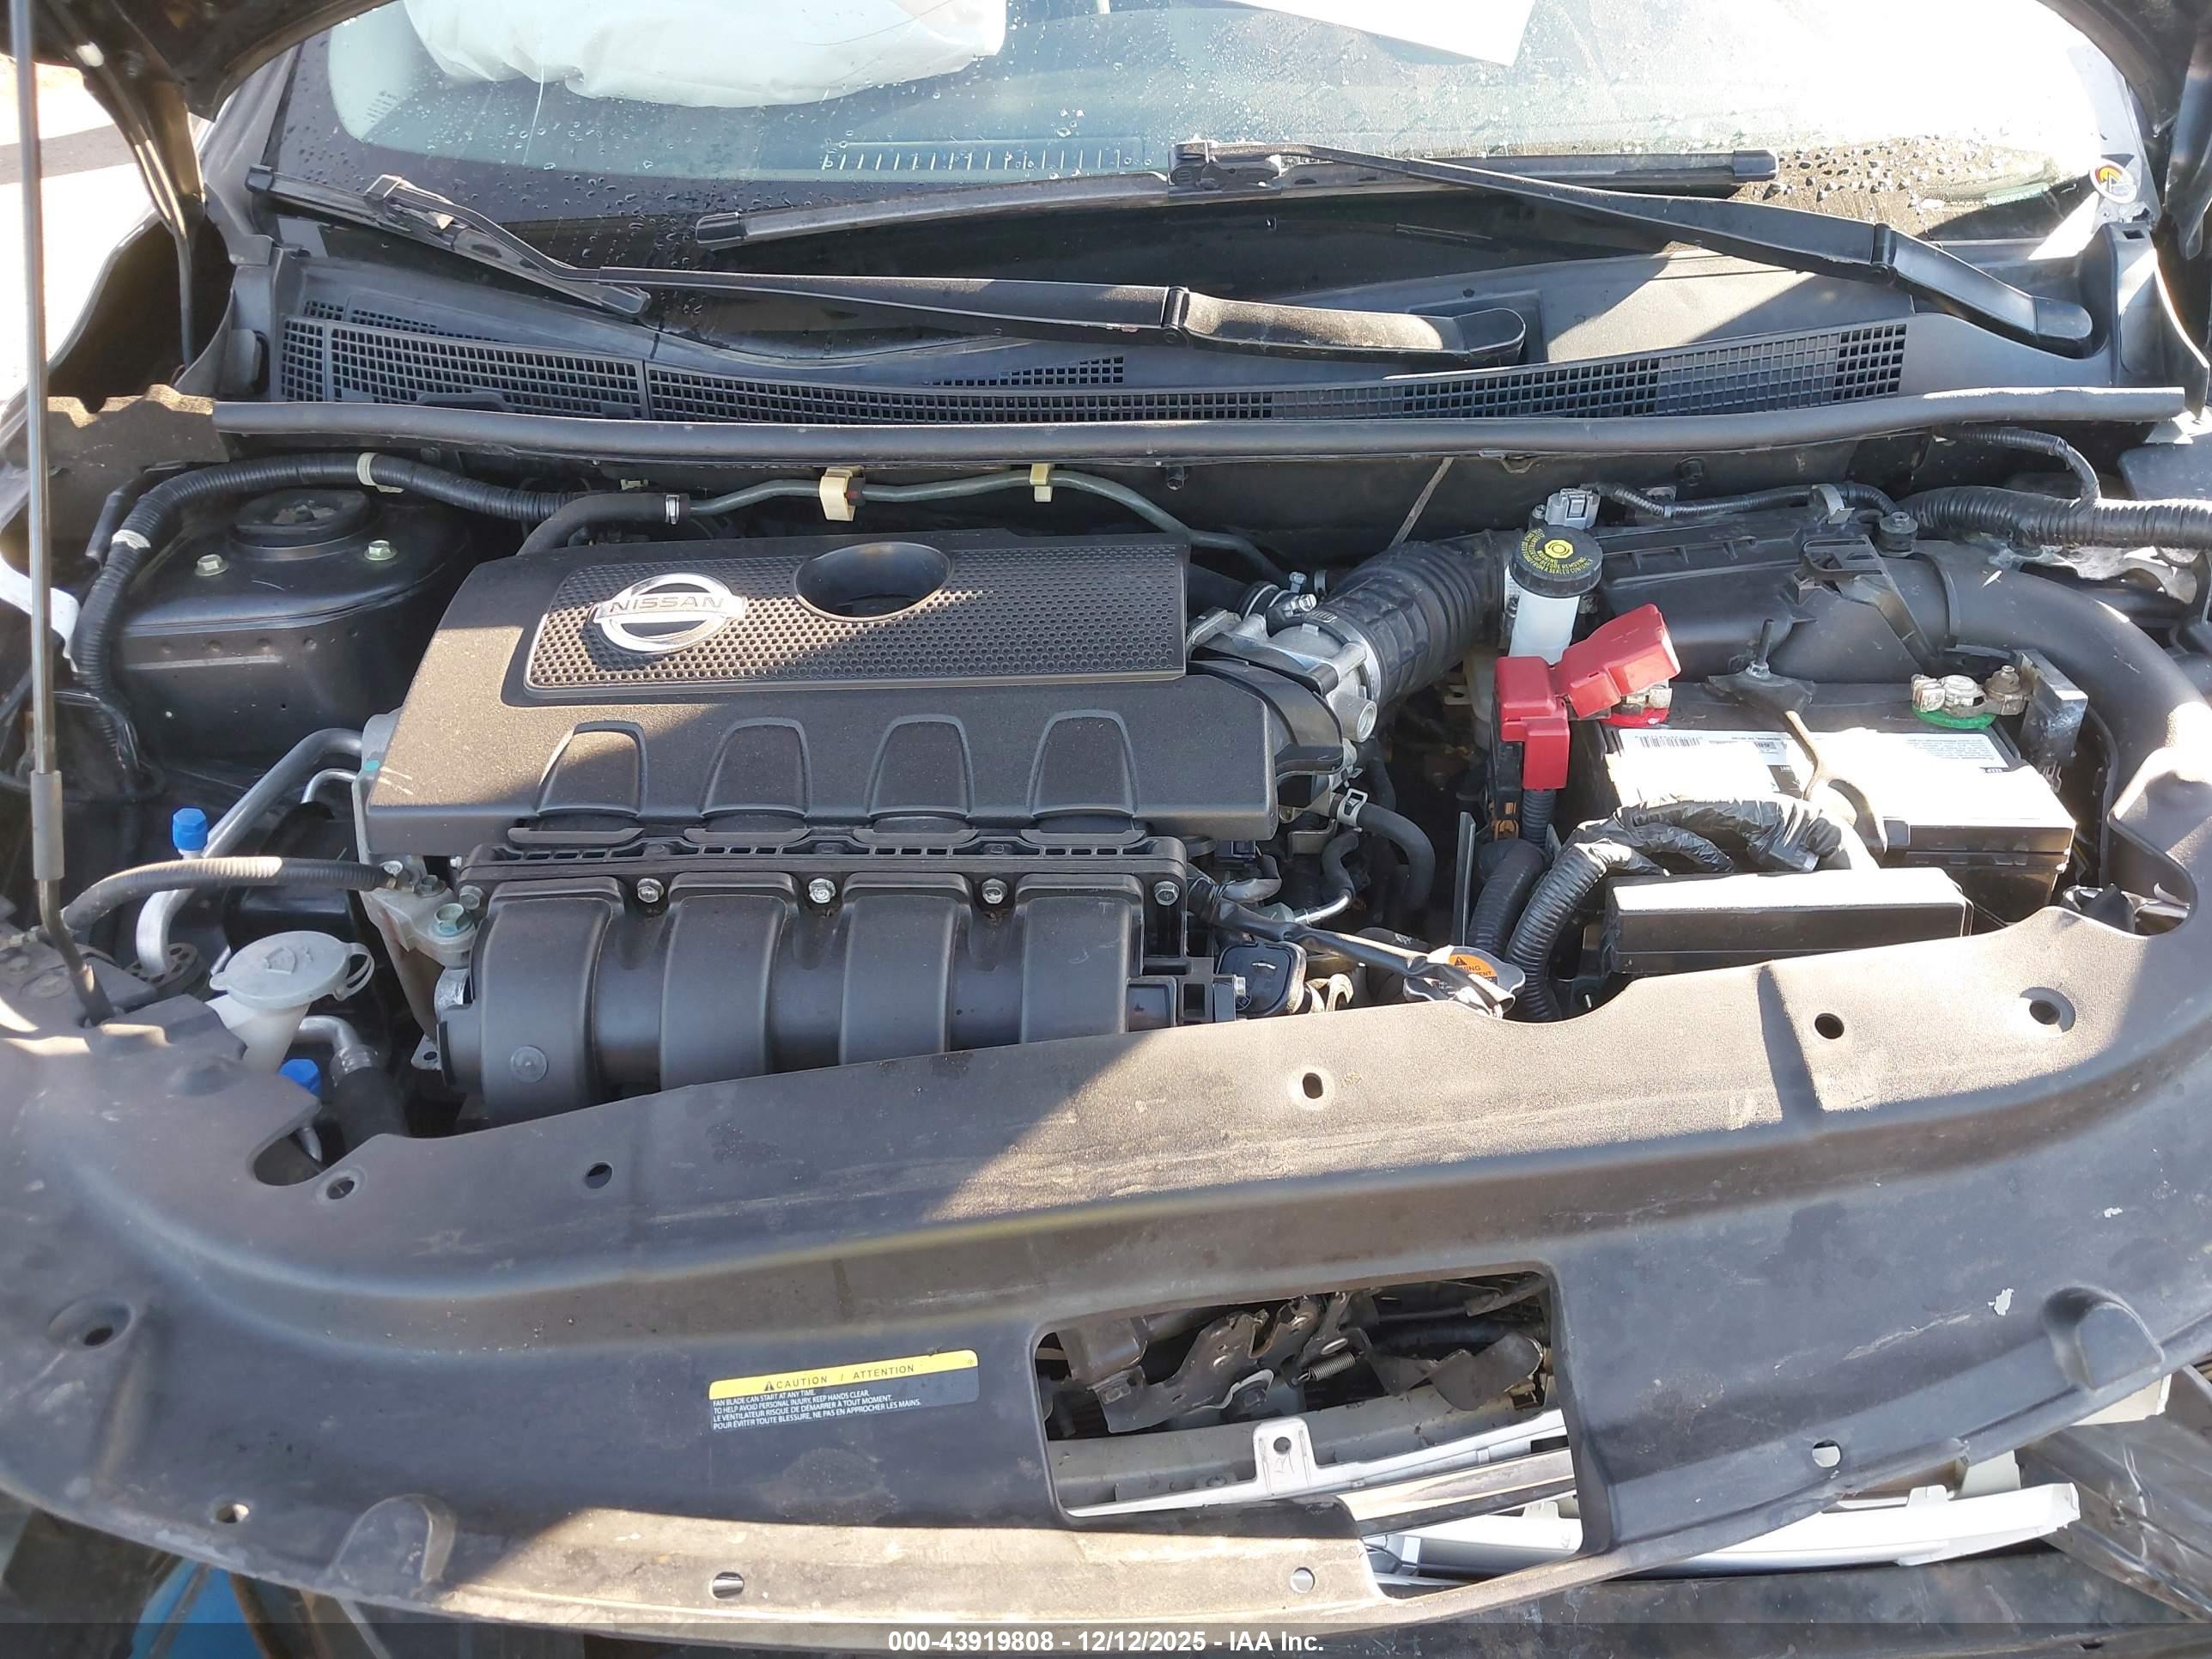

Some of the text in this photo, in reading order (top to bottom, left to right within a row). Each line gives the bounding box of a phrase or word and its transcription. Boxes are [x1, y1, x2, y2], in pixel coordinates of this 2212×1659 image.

[610, 596, 724, 613] NISSAN
[776, 1376, 827, 1389] CAUTION
[853, 1364, 914, 1379] ATTENTION
[722, 1410, 764, 1421] VENTILATEUR
[766, 1407, 789, 1416] RISQUE
[844, 1398, 861, 1407] TOUT
[724, 1405, 738, 1413] HELP
[759, 1399, 789, 1409] PERSONAL
[812, 1395, 826, 1403] KEEP
[828, 1392, 848, 1401] HANDS
[746, 1395, 759, 1403] CAN
[714, 1421, 732, 1430] POUR
[757, 1416, 778, 1425] TOUTE
[846, 1403, 884, 1413] APPROCHER
